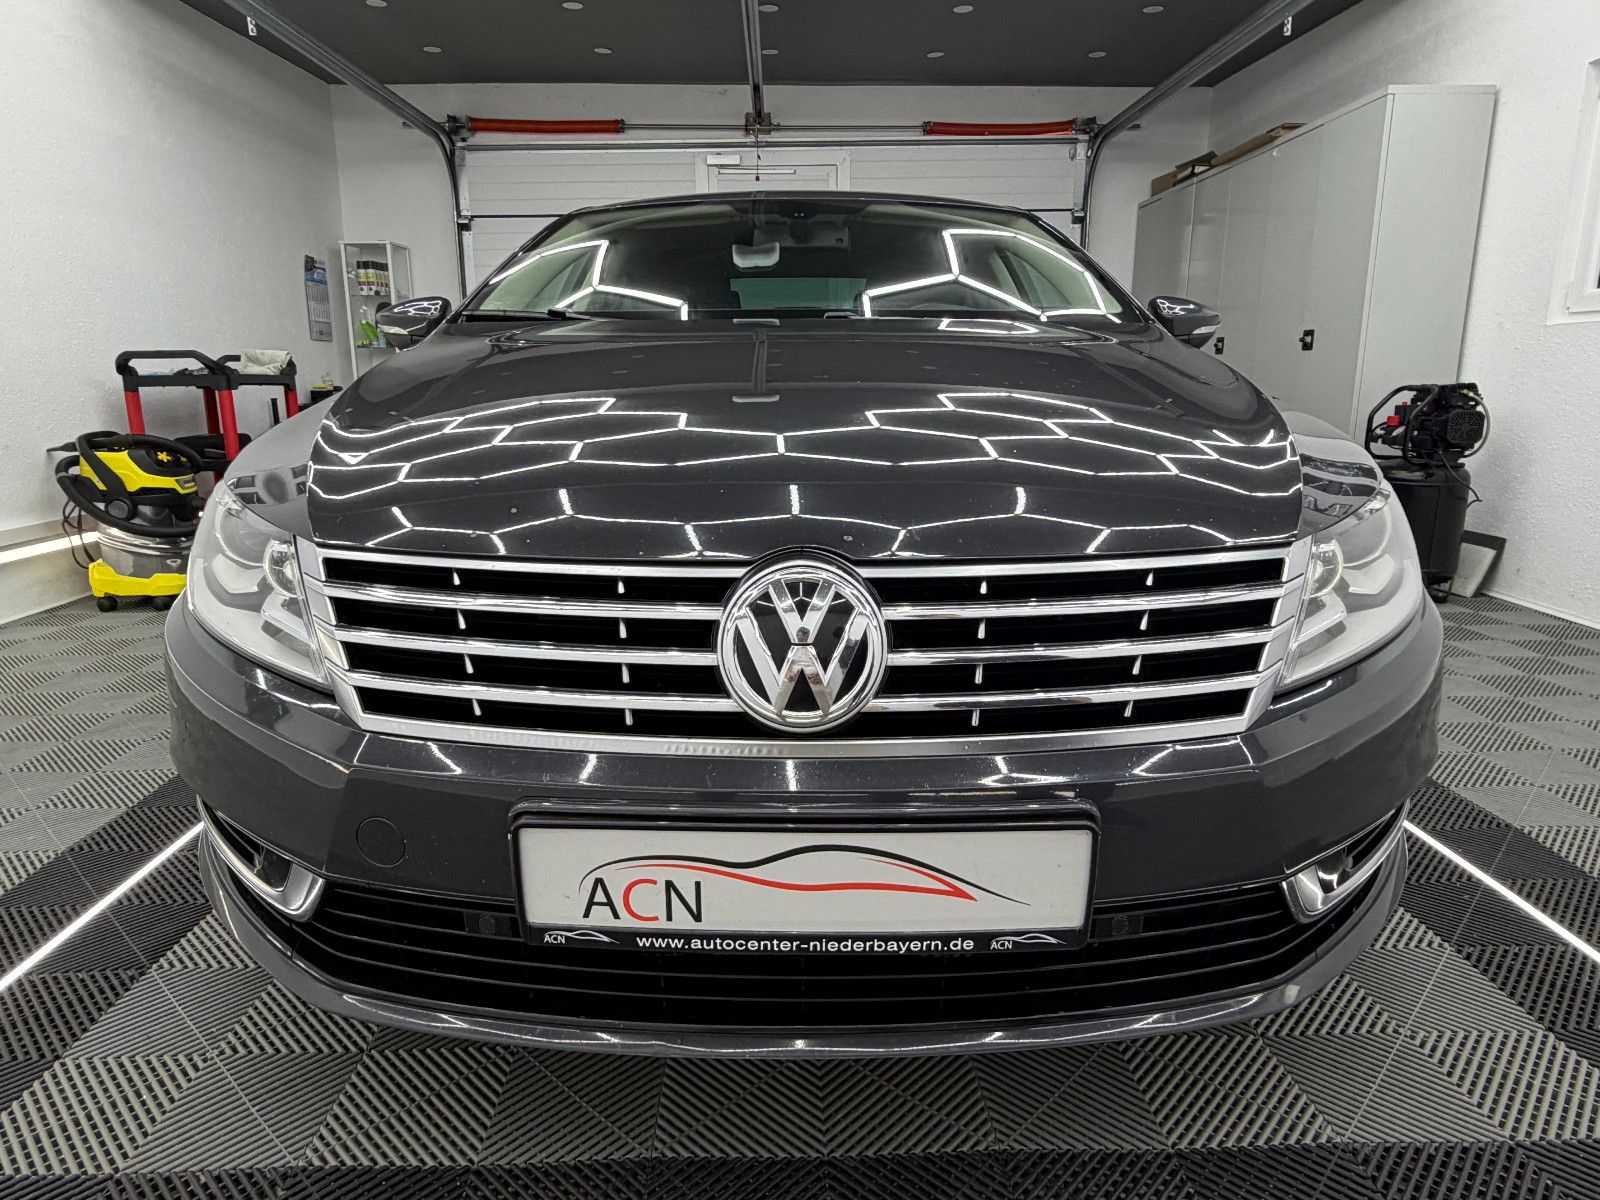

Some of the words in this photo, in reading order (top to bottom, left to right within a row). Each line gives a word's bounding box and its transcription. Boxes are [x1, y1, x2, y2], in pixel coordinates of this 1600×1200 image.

[582, 877, 702, 922] ACN
[543, 934, 566, 944] ACN
[636, 936, 975, 954] www.autocenter-niederbayern.de
[990, 940, 1013, 950] ACN
